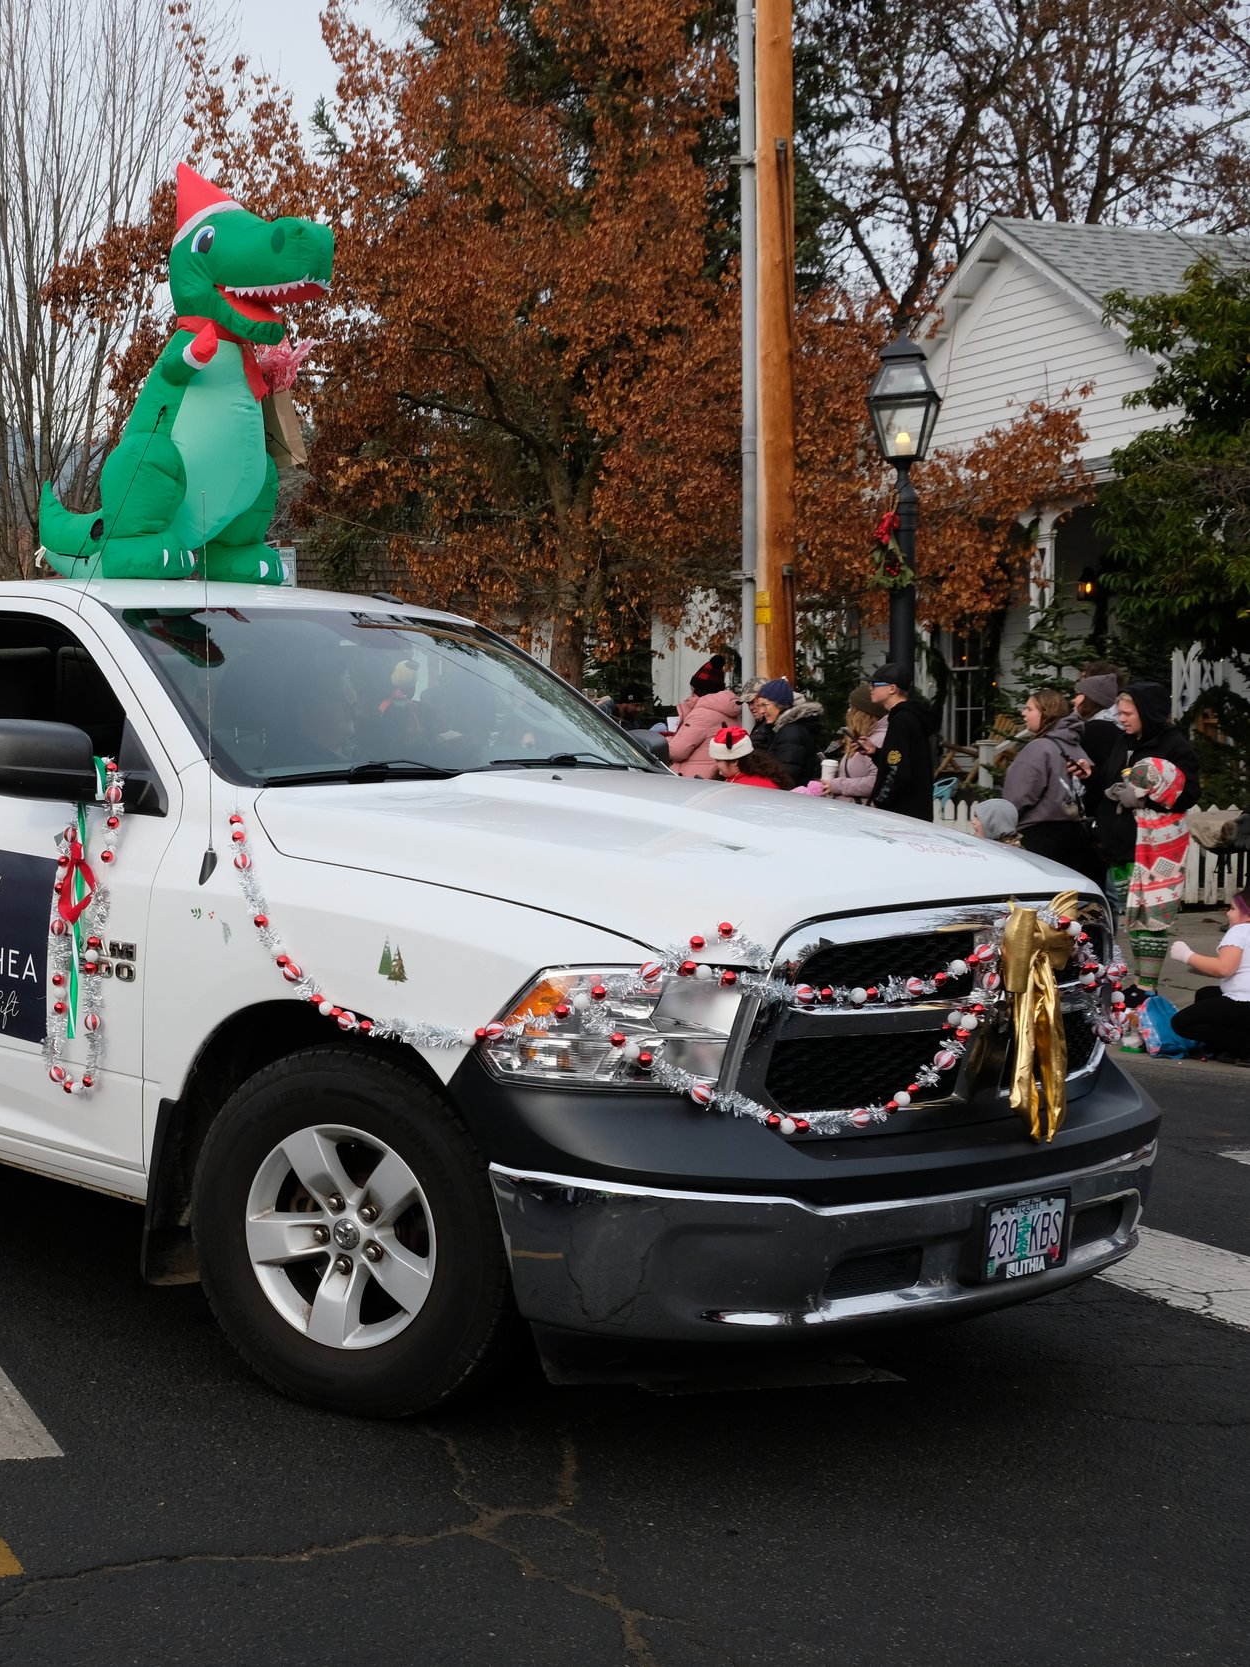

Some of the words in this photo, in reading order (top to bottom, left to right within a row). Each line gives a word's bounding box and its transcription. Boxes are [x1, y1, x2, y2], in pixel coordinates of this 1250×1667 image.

[989, 1218, 1019, 1259] 230
[1029, 1210, 1062, 1253] KBS
[1015, 1255, 1046, 1277] LITHIA
